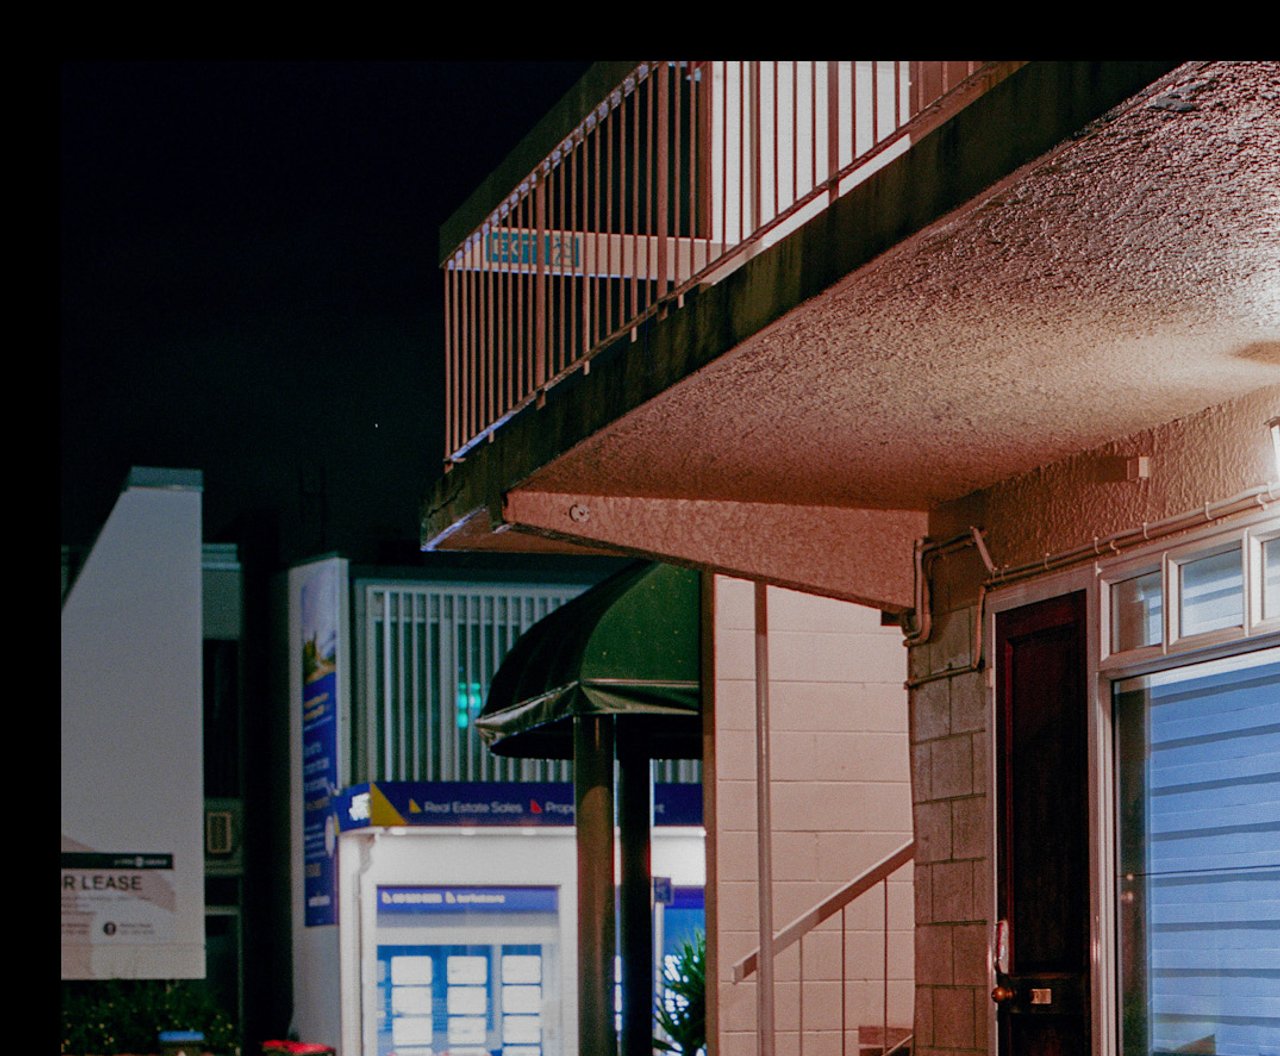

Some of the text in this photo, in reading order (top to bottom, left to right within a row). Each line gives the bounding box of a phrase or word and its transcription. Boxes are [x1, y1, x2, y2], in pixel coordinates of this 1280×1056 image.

[424, 801, 449, 813] Real
[452, 801, 489, 813] Estate
[491, 801, 523, 813] Sales
[82, 875, 142, 890] LEASE
